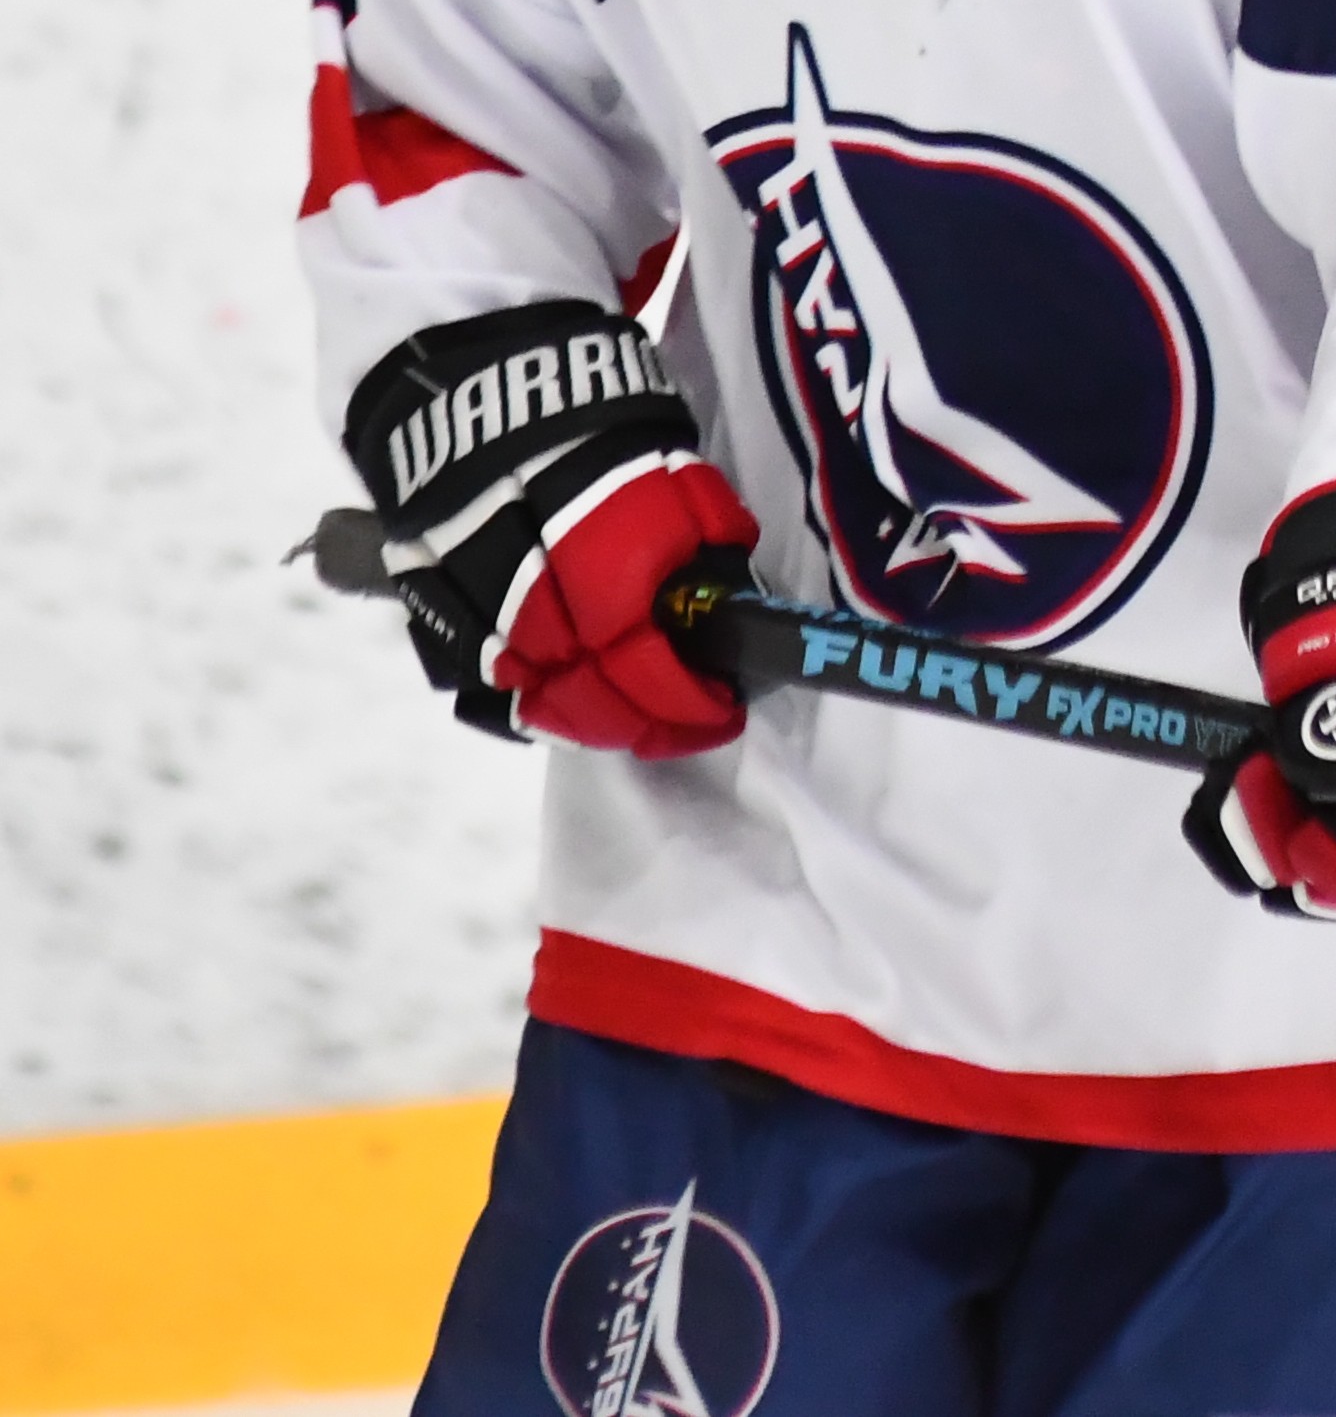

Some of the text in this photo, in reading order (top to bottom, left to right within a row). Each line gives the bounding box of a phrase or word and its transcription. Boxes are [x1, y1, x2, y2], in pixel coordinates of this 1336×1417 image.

[800, 624, 1043, 721] FURY
[1046, 684, 1105, 738] FX
[1103, 696, 1187, 747] PRO
